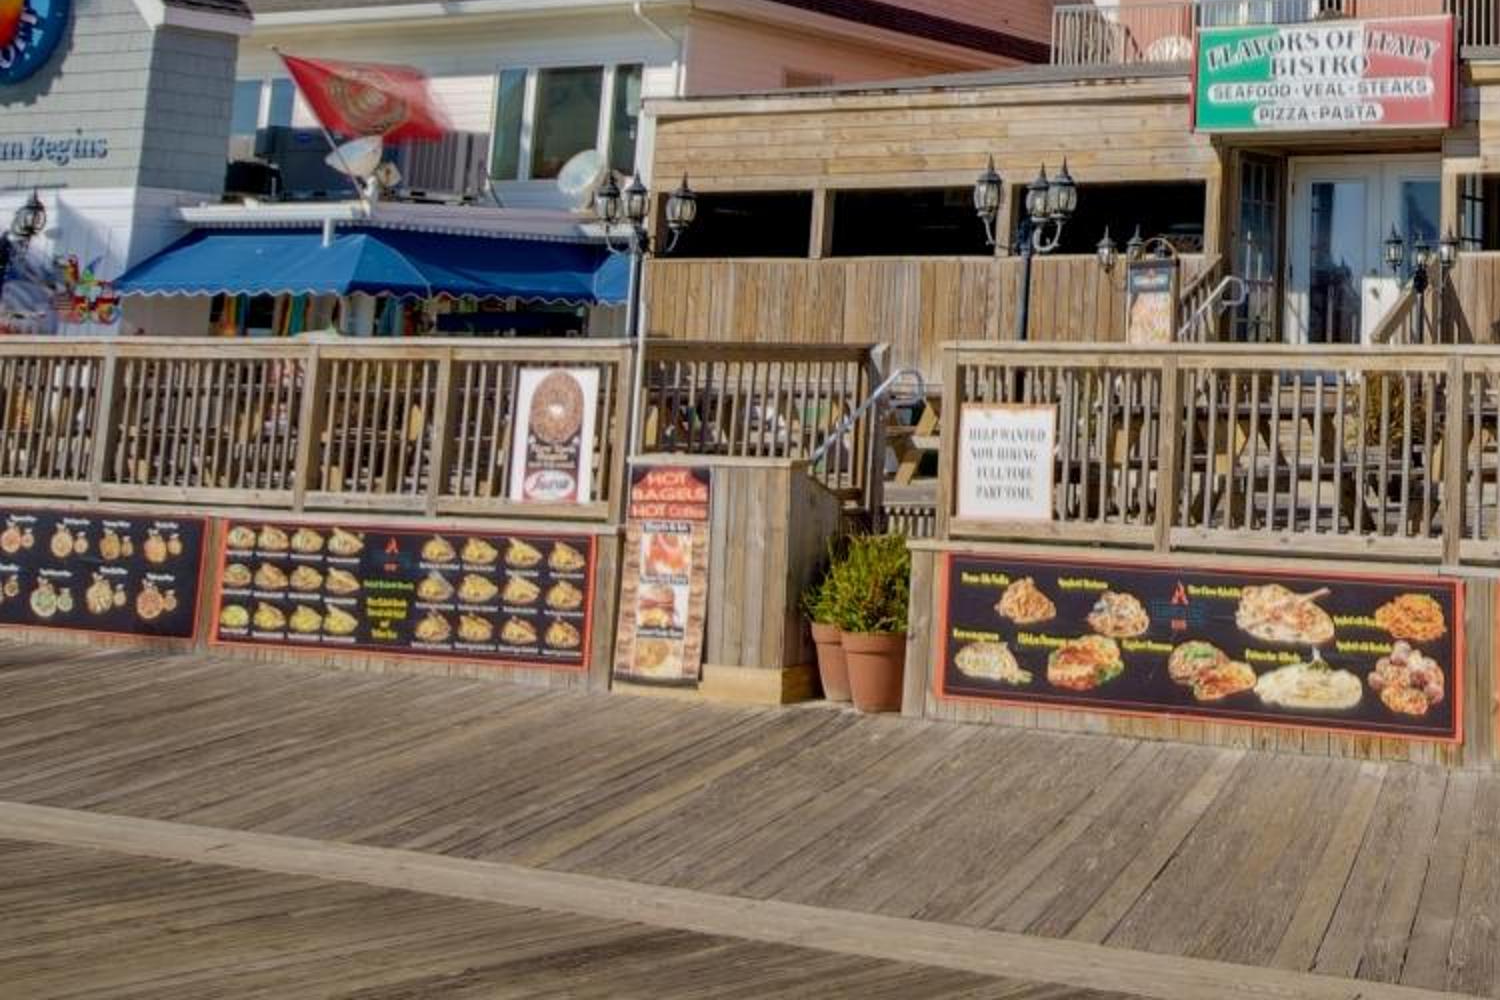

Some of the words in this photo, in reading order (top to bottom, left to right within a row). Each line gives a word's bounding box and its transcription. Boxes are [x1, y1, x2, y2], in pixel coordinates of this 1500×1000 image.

[1208, 31, 1319, 69] FLAVORS
[1326, 30, 1356, 50] OF
[1365, 32, 1438, 62] ITALY
[1269, 55, 1368, 77] BISTRO
[1212, 83, 1291, 99] SEAFOOD
[1303, 81, 1346, 97] VEAL
[1357, 78, 1428, 95] STEAKS
[1258, 107, 1311, 121] PIZZA
[1319, 104, 1378, 120] PASTA
[647, 472, 687, 487] HOT
[631, 503, 666, 517] HOT
